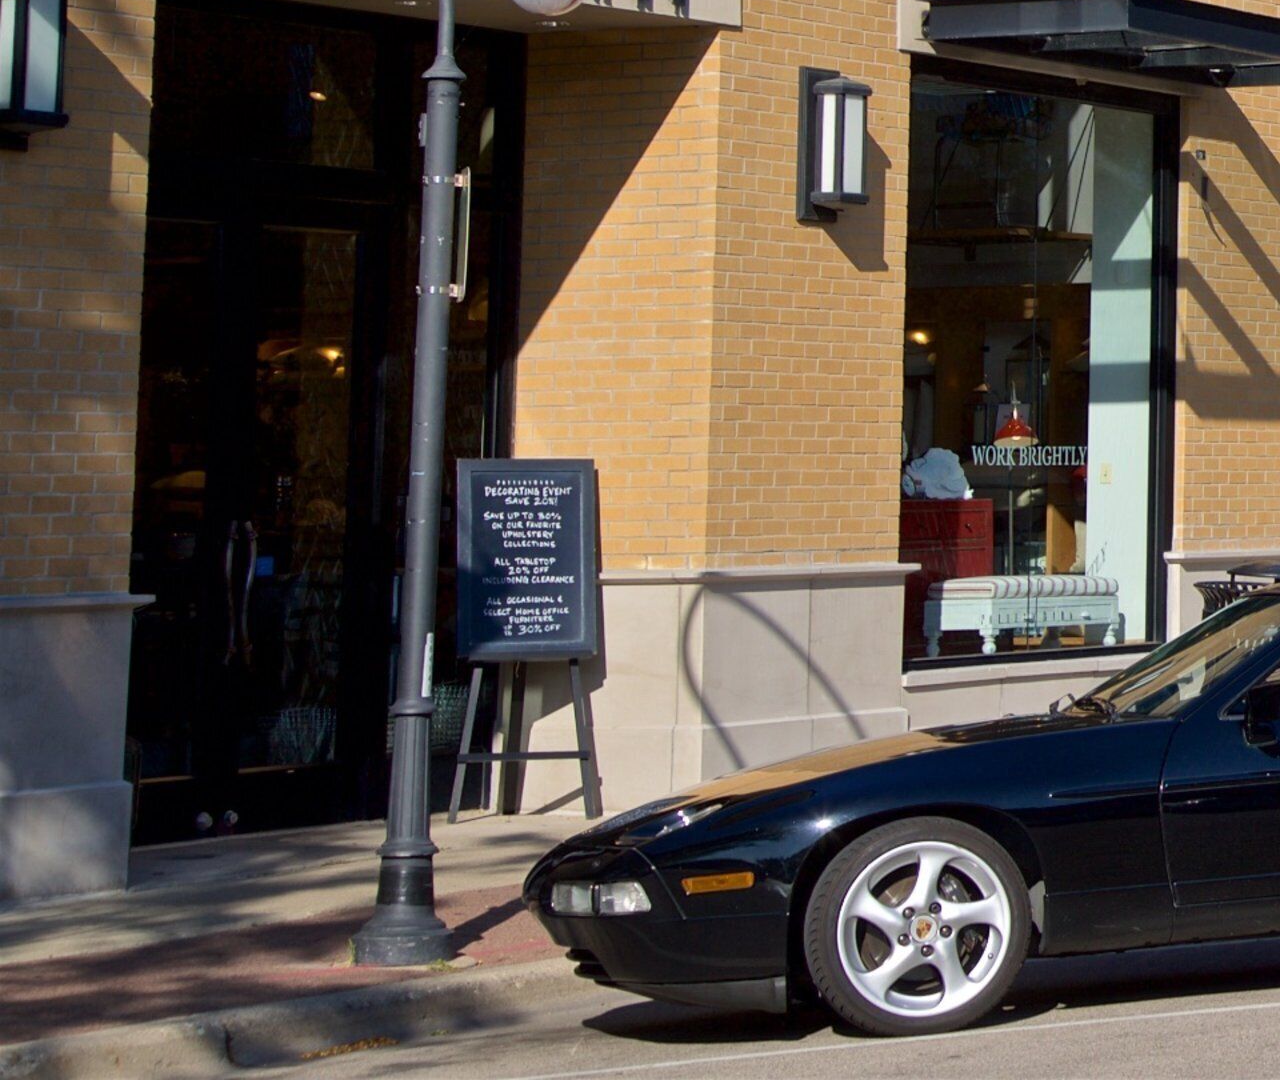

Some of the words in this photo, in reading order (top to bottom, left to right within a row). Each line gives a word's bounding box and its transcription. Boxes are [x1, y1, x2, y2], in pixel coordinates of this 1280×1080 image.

[972, 445, 1016, 466] WORK
[1018, 445, 1088, 466] BRIGHTLY
[484, 486, 540, 497] DECORATING
[543, 486, 572, 497] EVENT
[505, 496, 530, 505] SAVE
[483, 511, 504, 520] SAVE
[507, 512, 520, 520] UP
[522, 512, 534, 520] TO
[491, 522, 503, 530] ON
[506, 521, 524, 529] OUR
[526, 521, 562, 530] FAVORITE
[502, 530, 554, 539] UPHOLSTERY
[503, 540, 556, 548] COLLECTIONS
[494, 557, 511, 567] ALL
[514, 557, 556, 566] TABLETOP
[508, 567, 530, 575] 20%
[533, 566, 550, 574] OFF
[482, 576, 529, 584] INCLUDING
[531, 576, 575, 584] CLEARANCE
[486, 597, 502, 605] ALL
[506, 596, 554, 605] OCCASIONAL
[483, 607, 511, 616] SELECT
[515, 608, 540, 616] HOME
[542, 607, 570, 616] OFFICE
[508, 616, 554, 624] FURNITURE
[518, 624, 543, 635] 30%
